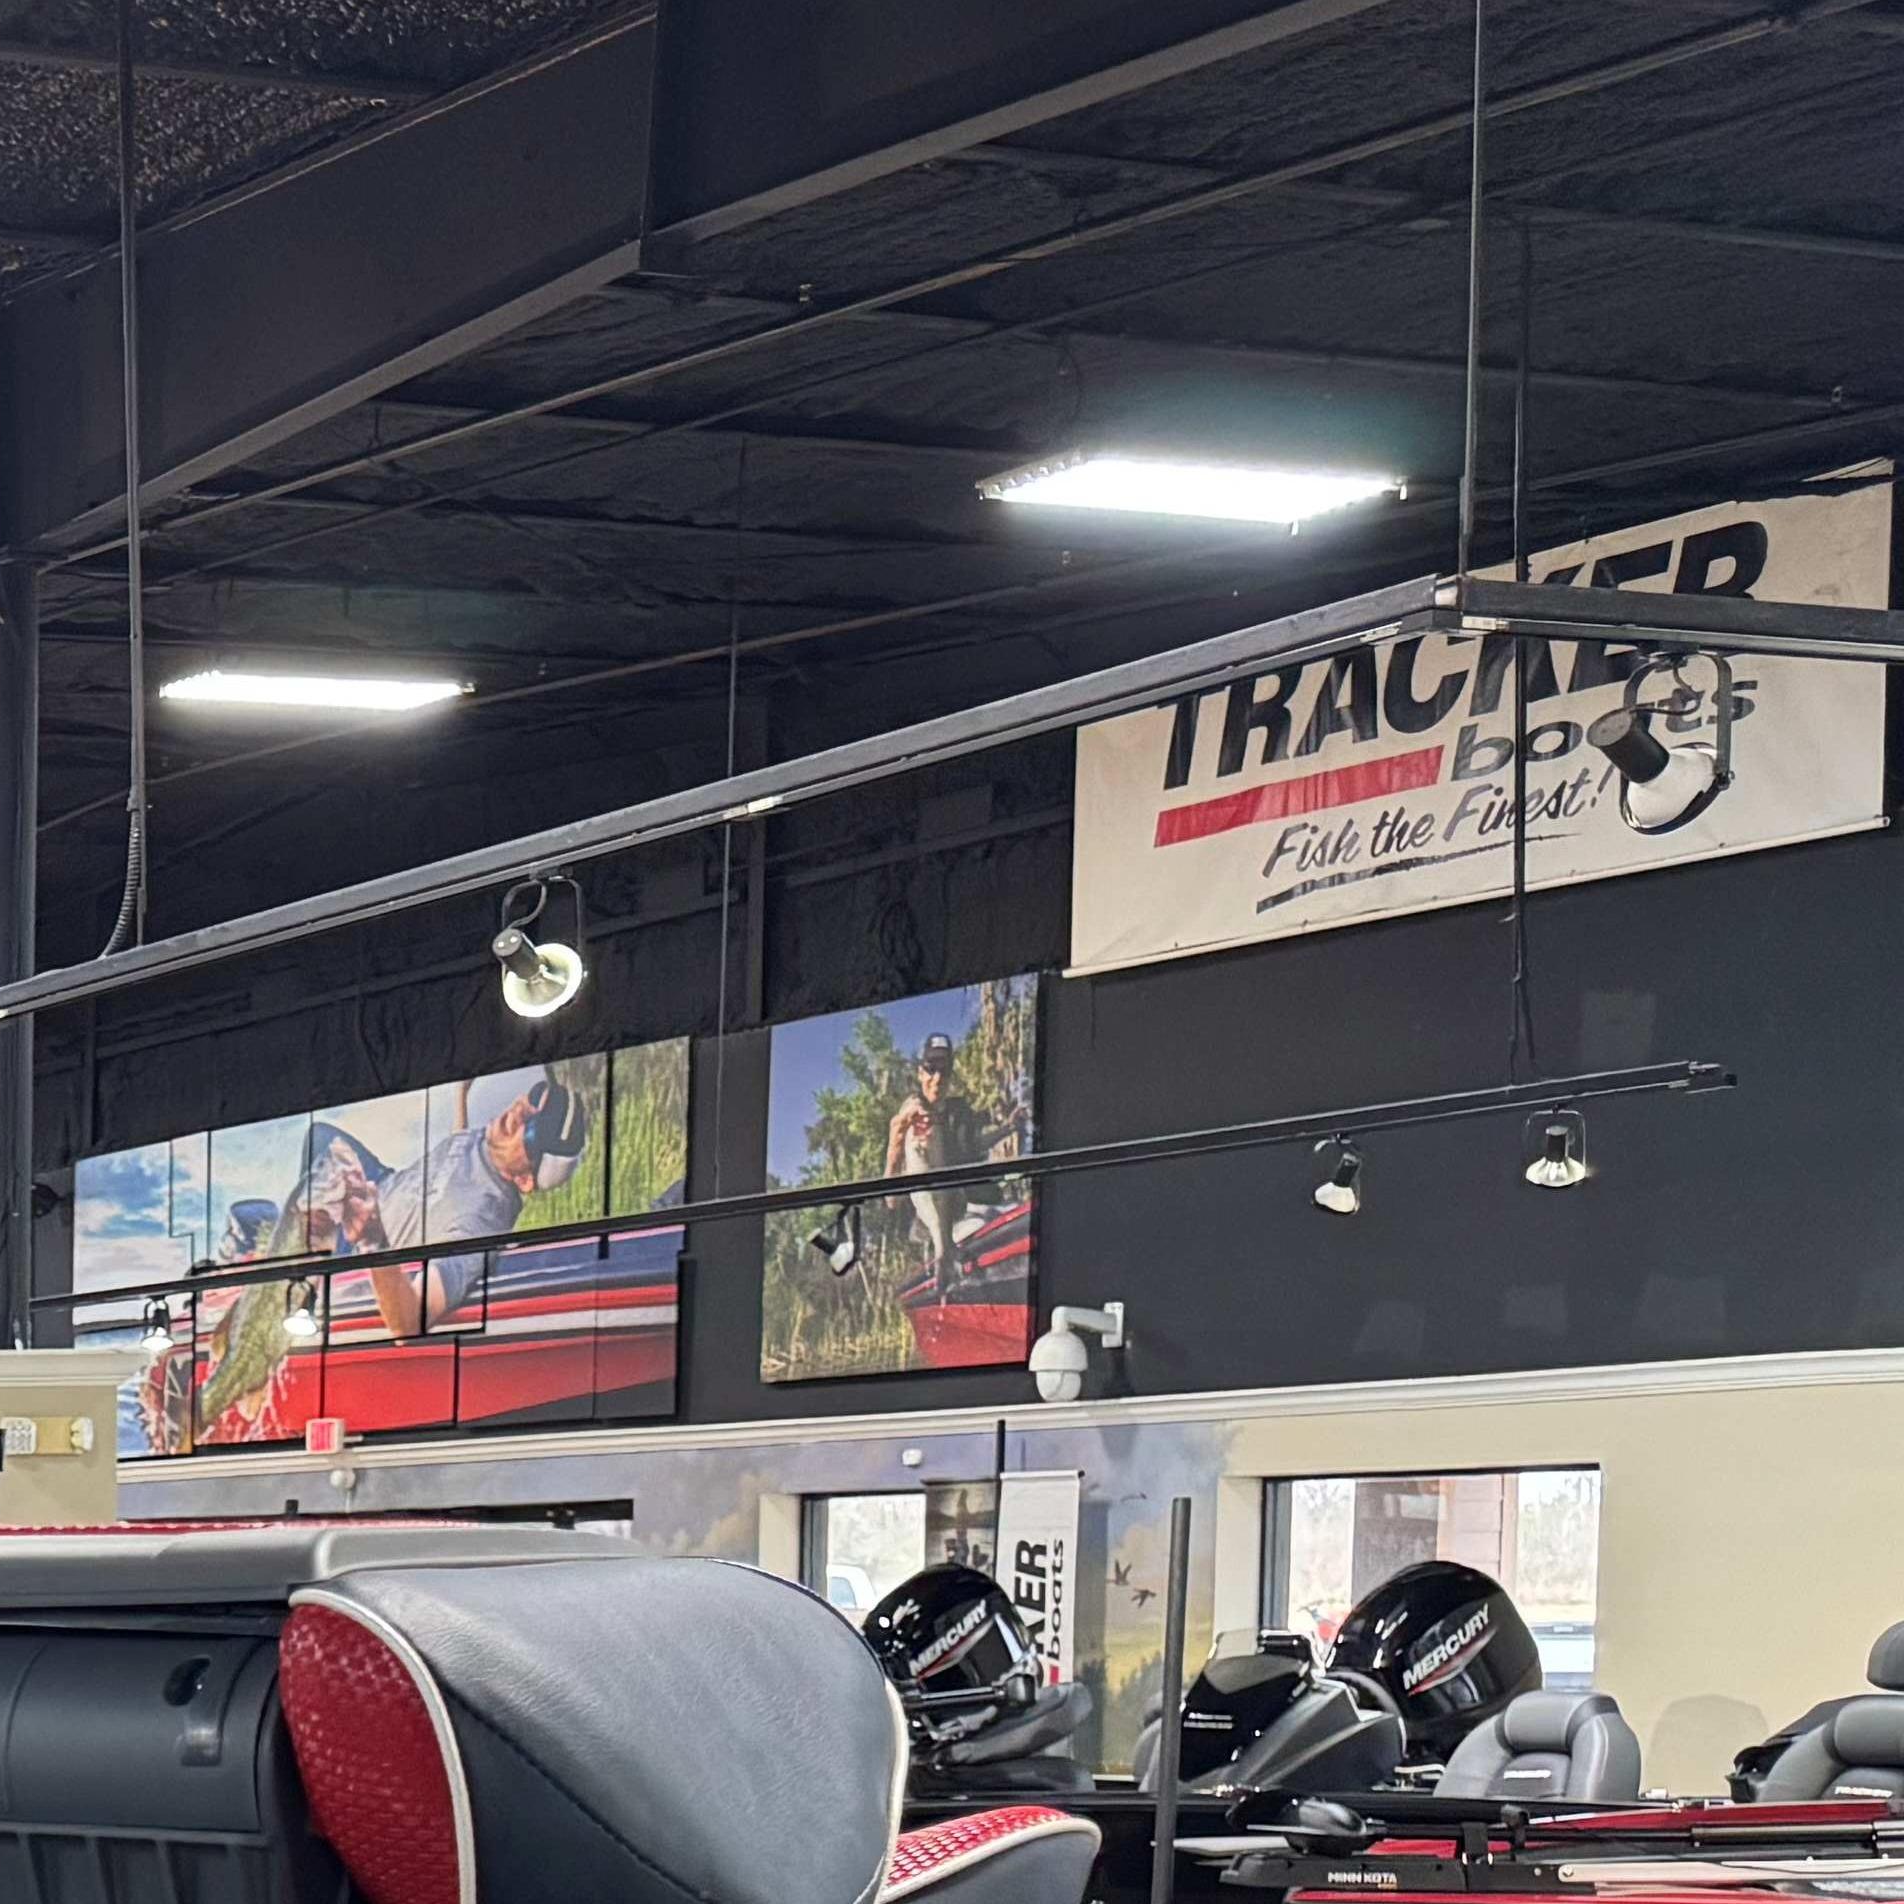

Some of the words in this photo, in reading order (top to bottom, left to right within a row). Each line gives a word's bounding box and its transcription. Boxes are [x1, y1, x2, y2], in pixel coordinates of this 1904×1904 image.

[1262, 817, 1362, 880] Fish
[1371, 804, 1435, 858] the
[909, 1598, 988, 1677] MERCURY
[1046, 1538, 1064, 1661] boats
[1402, 1602, 1492, 1690] MERCURY
[1328, 1872, 1362, 1883] MINN
[1363, 1872, 1398, 1884] KOTA
